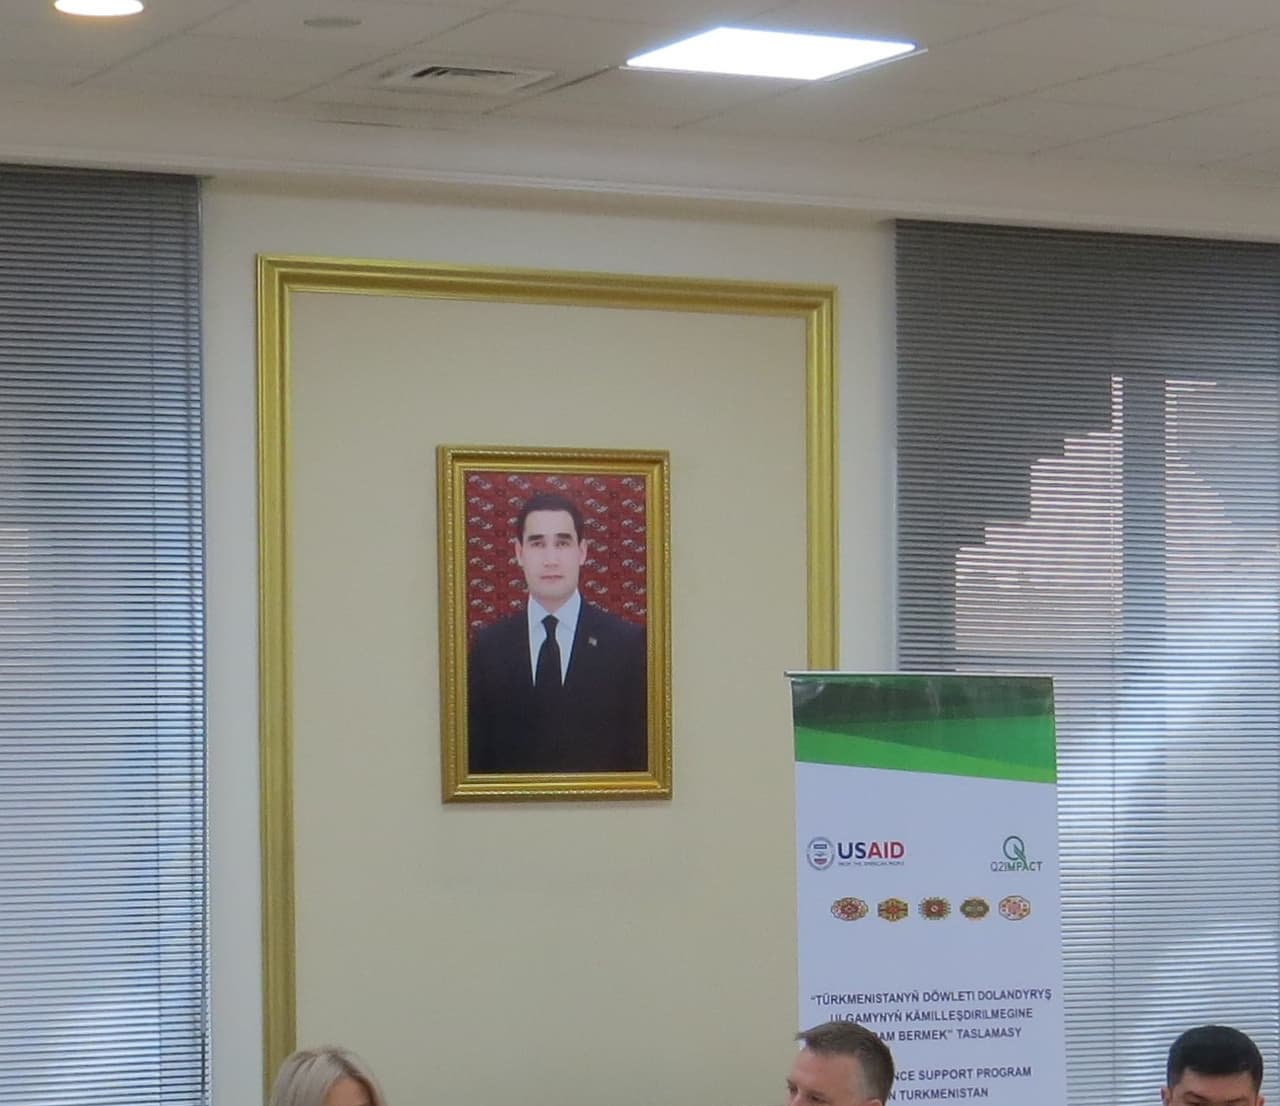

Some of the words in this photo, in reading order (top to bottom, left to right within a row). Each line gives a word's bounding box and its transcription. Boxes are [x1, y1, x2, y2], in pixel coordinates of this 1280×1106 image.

[837, 842, 905, 859] USAID
[923, 989, 975, 1002] DÖWLETI
[956, 1027, 1022, 1039] TASLAMASY
[918, 1068, 974, 1080] SUPPORT
[976, 1067, 1032, 1078] PROGRAM
[899, 1087, 989, 1101] TURKMENISTAN
